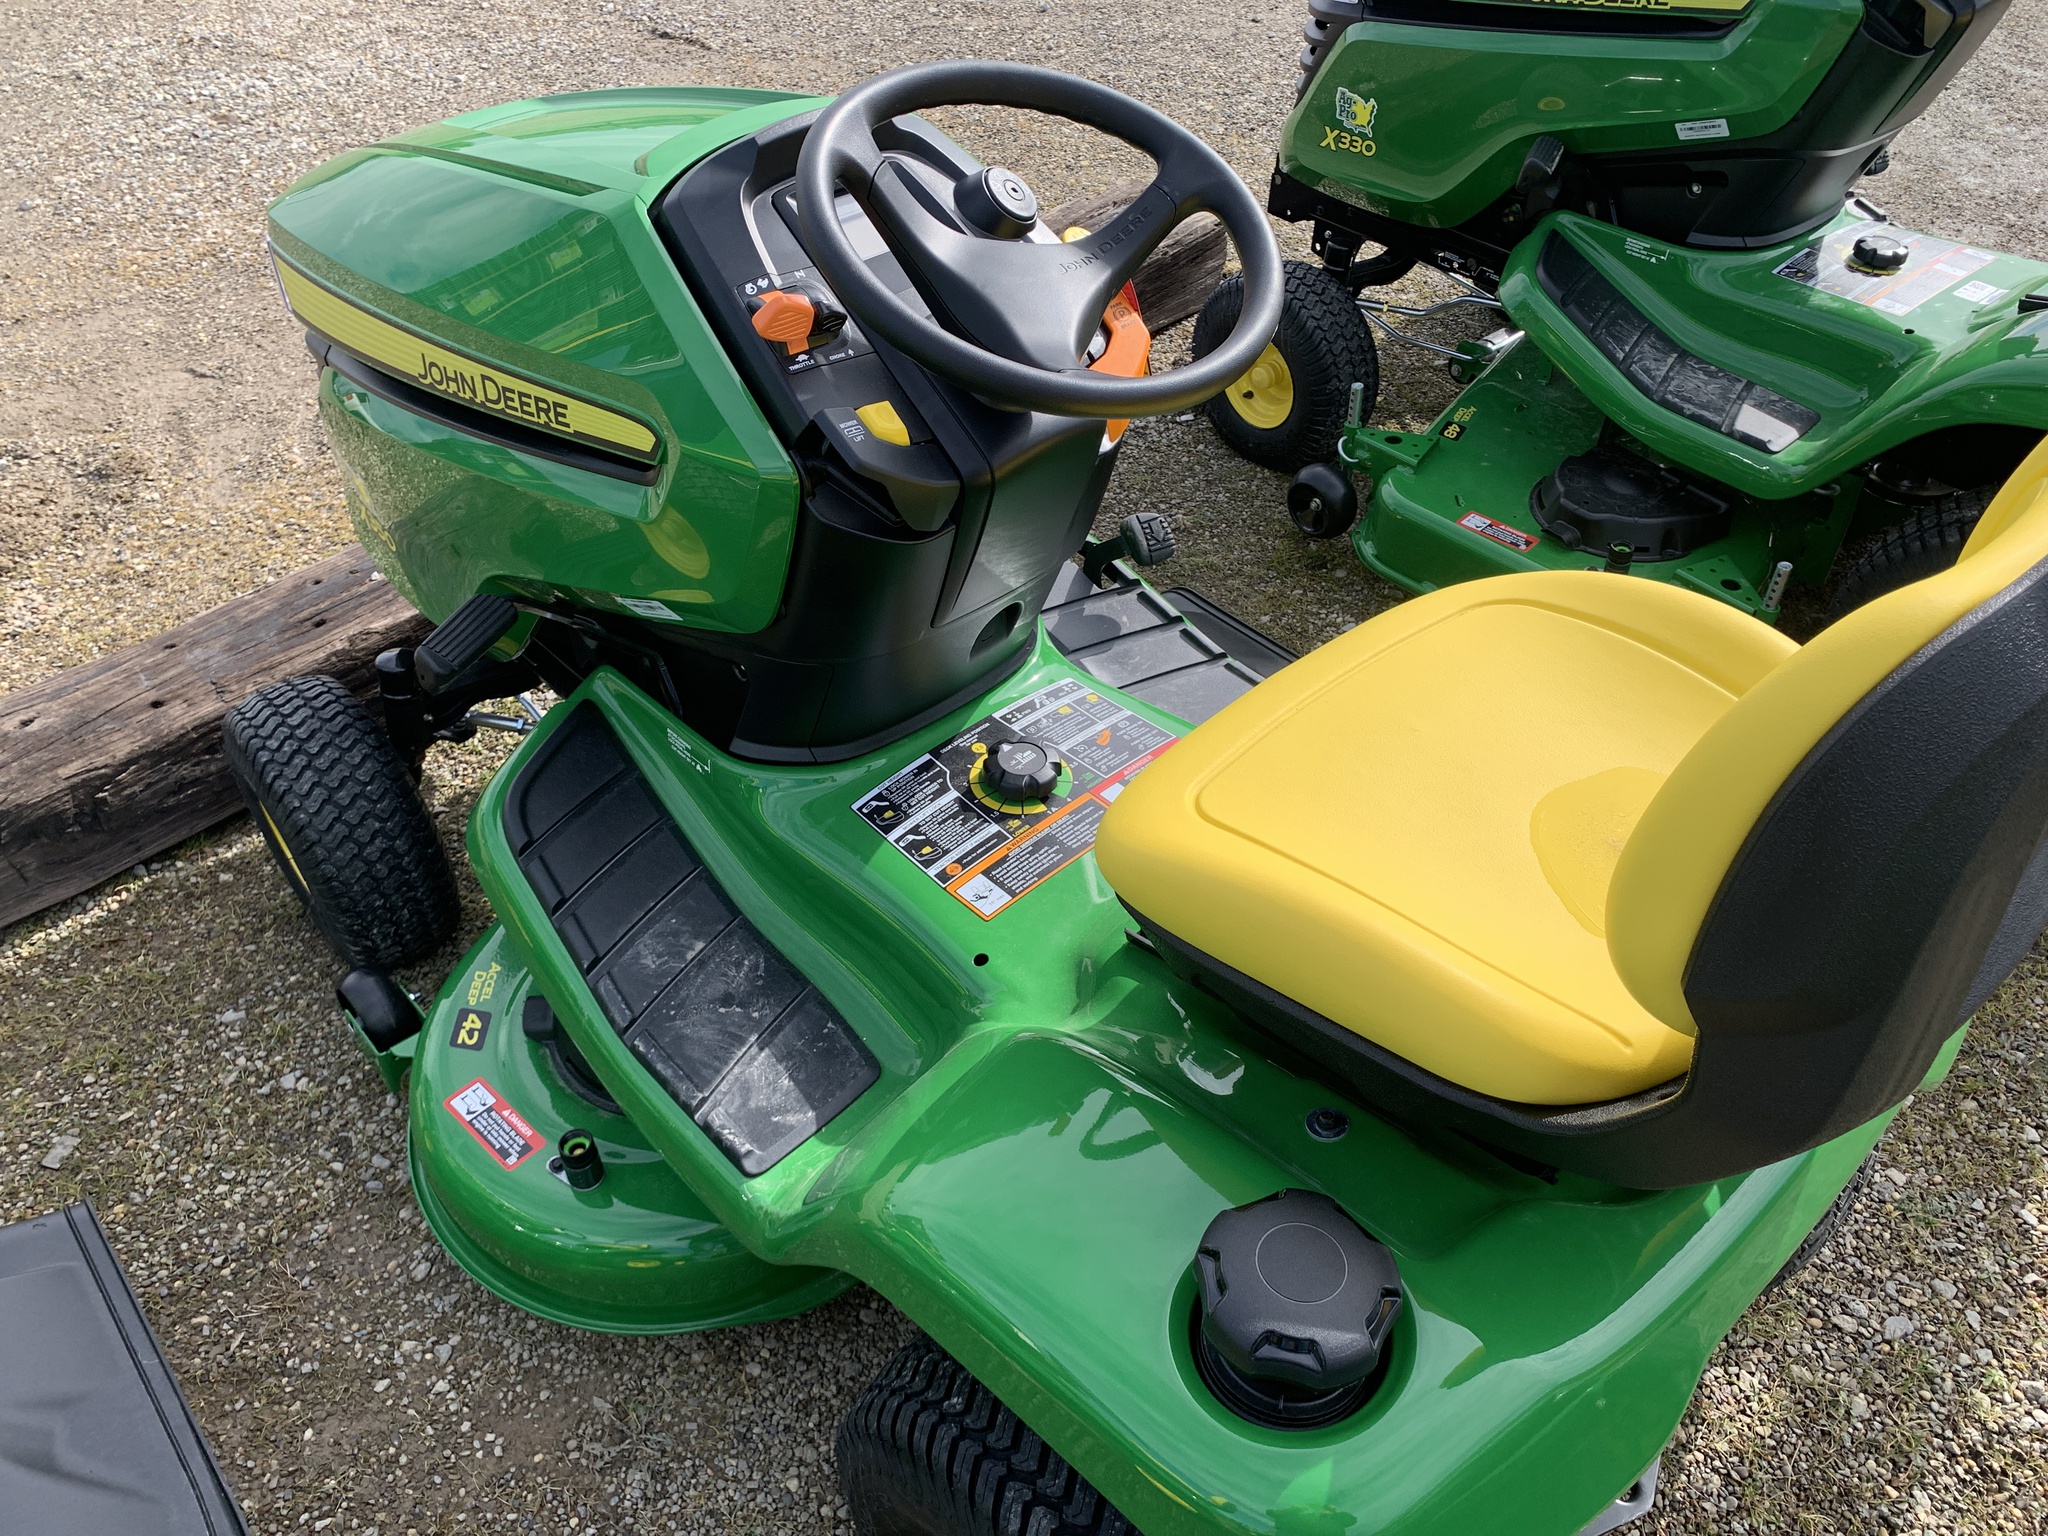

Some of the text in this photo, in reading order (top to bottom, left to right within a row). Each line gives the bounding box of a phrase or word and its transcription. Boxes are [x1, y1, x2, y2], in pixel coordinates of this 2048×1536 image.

[1338, 92, 1356, 108] Ag-
[1338, 104, 1356, 120] Pro
[1318, 125, 1377, 157] X330
[1059, 206, 1153, 275] JOHN DEERE
[788, 360, 816, 371] THROTTLE
[829, 352, 846, 360] CHOKE
[418, 352, 571, 429] JOHN DEERE
[1454, 407, 1468, 422] DEEP
[1460, 406, 1478, 422] ACCEL
[1444, 424, 1460, 438] 48
[1127, 755, 1153, 773] DANGER
[876, 771, 903, 790] CUT HEIGHT
[940, 800, 955, 811] HEIGHT
[901, 818, 919, 830] MOWER
[919, 810, 930, 818] LIFT
[929, 802, 941, 811] LOCK
[1010, 827, 1039, 846] WARNING
[1012, 824, 1030, 837] LOWER
[468, 970, 486, 1006] DEEP
[480, 962, 501, 1002] ACCEL
[457, 1013, 482, 1045] 42
[488, 1110, 526, 1146] ROTATING BLADE
[507, 1112, 534, 1137] DANGER
